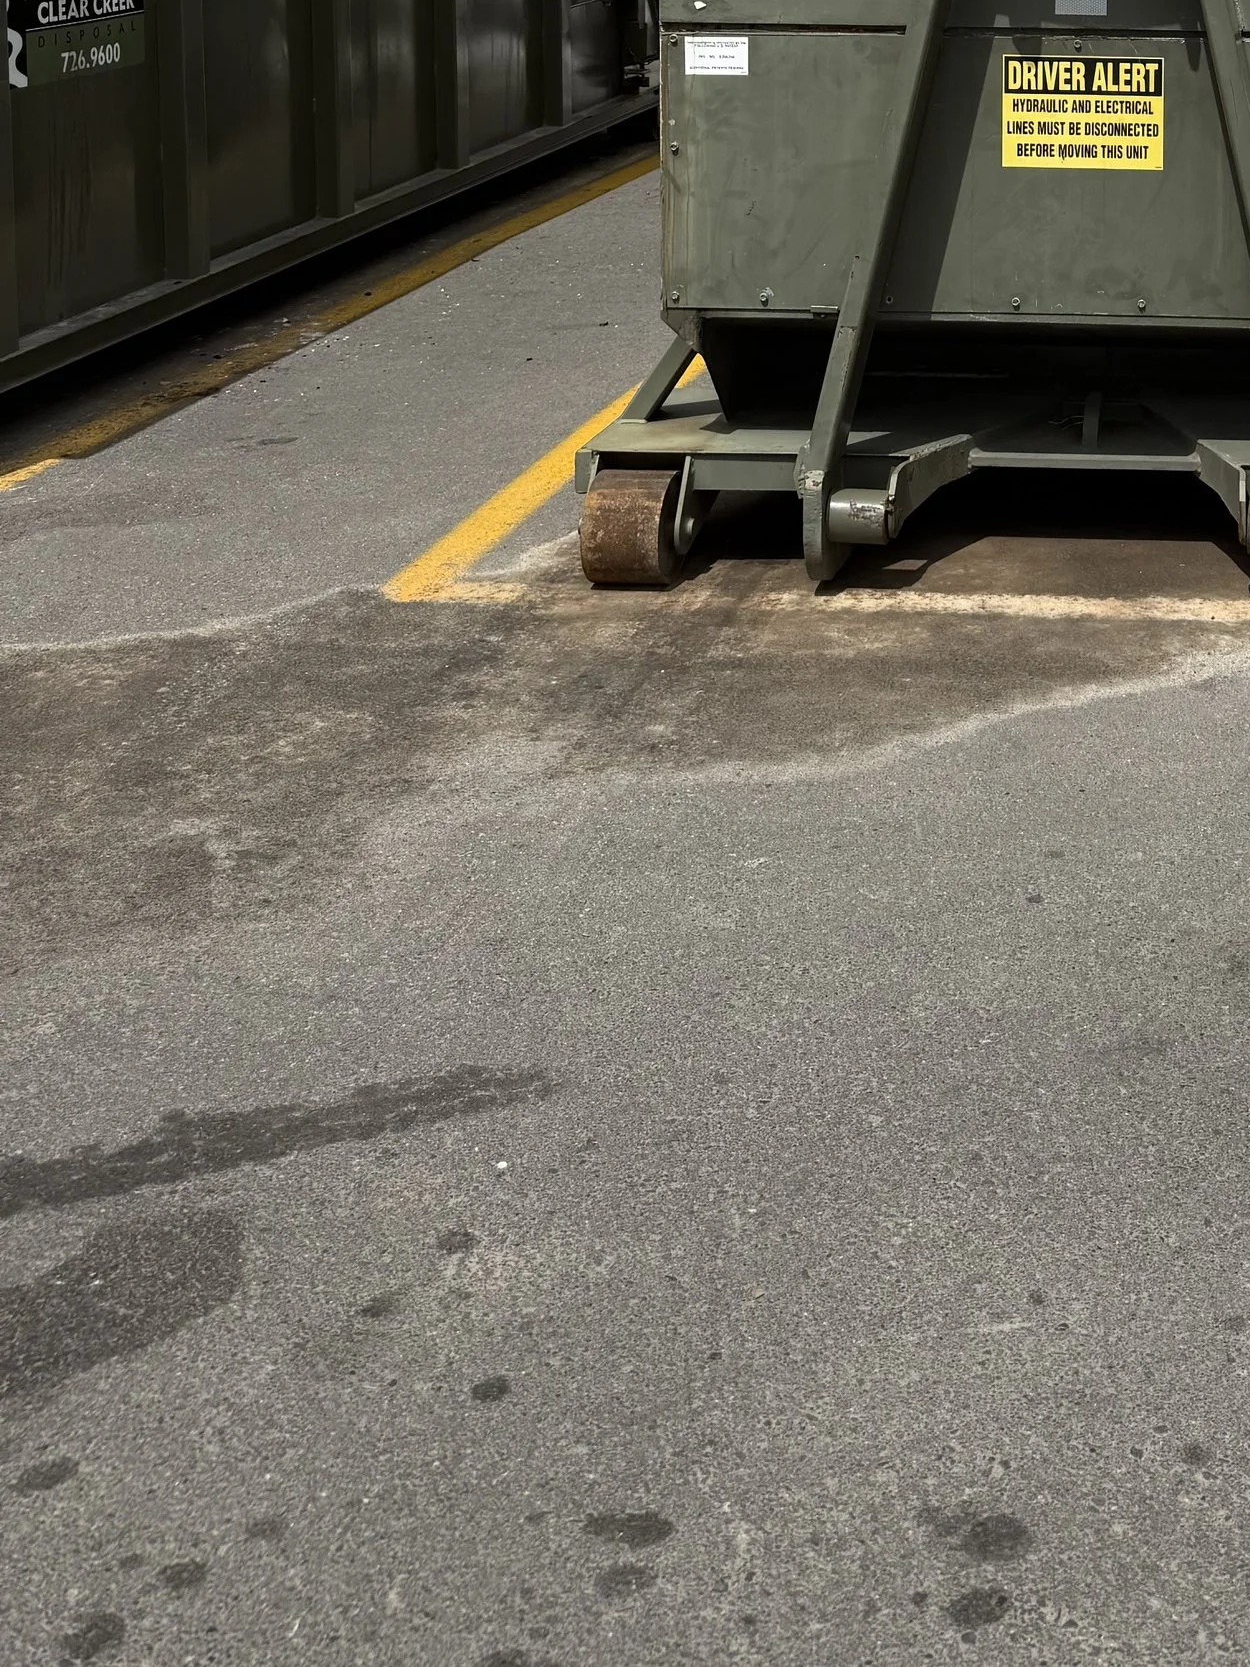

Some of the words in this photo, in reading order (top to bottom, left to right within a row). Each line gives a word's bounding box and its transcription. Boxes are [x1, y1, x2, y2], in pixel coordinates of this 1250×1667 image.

[38, 21, 136, 48] DISPOSAL
[60, 42, 121, 73] 726.9600
[1008, 60, 1086, 91] DRIVER
[1092, 62, 1159, 93] ALERT
[1012, 98, 1068, 113] HYDRAULIC
[1071, 100, 1091, 114] AND
[1095, 100, 1154, 115] ELECTRICAL
[1007, 121, 1034, 135] LINES
[1037, 121, 1065, 135] MUST
[1068, 122, 1081, 136] BE
[1084, 122, 1159, 137] DISCONNECTED
[1017, 143, 1055, 157] BEFORE
[1058, 144, 1098, 159] MOVING
[1101, 145, 1123, 159] THIS
[1126, 145, 1149, 159] UNIT
